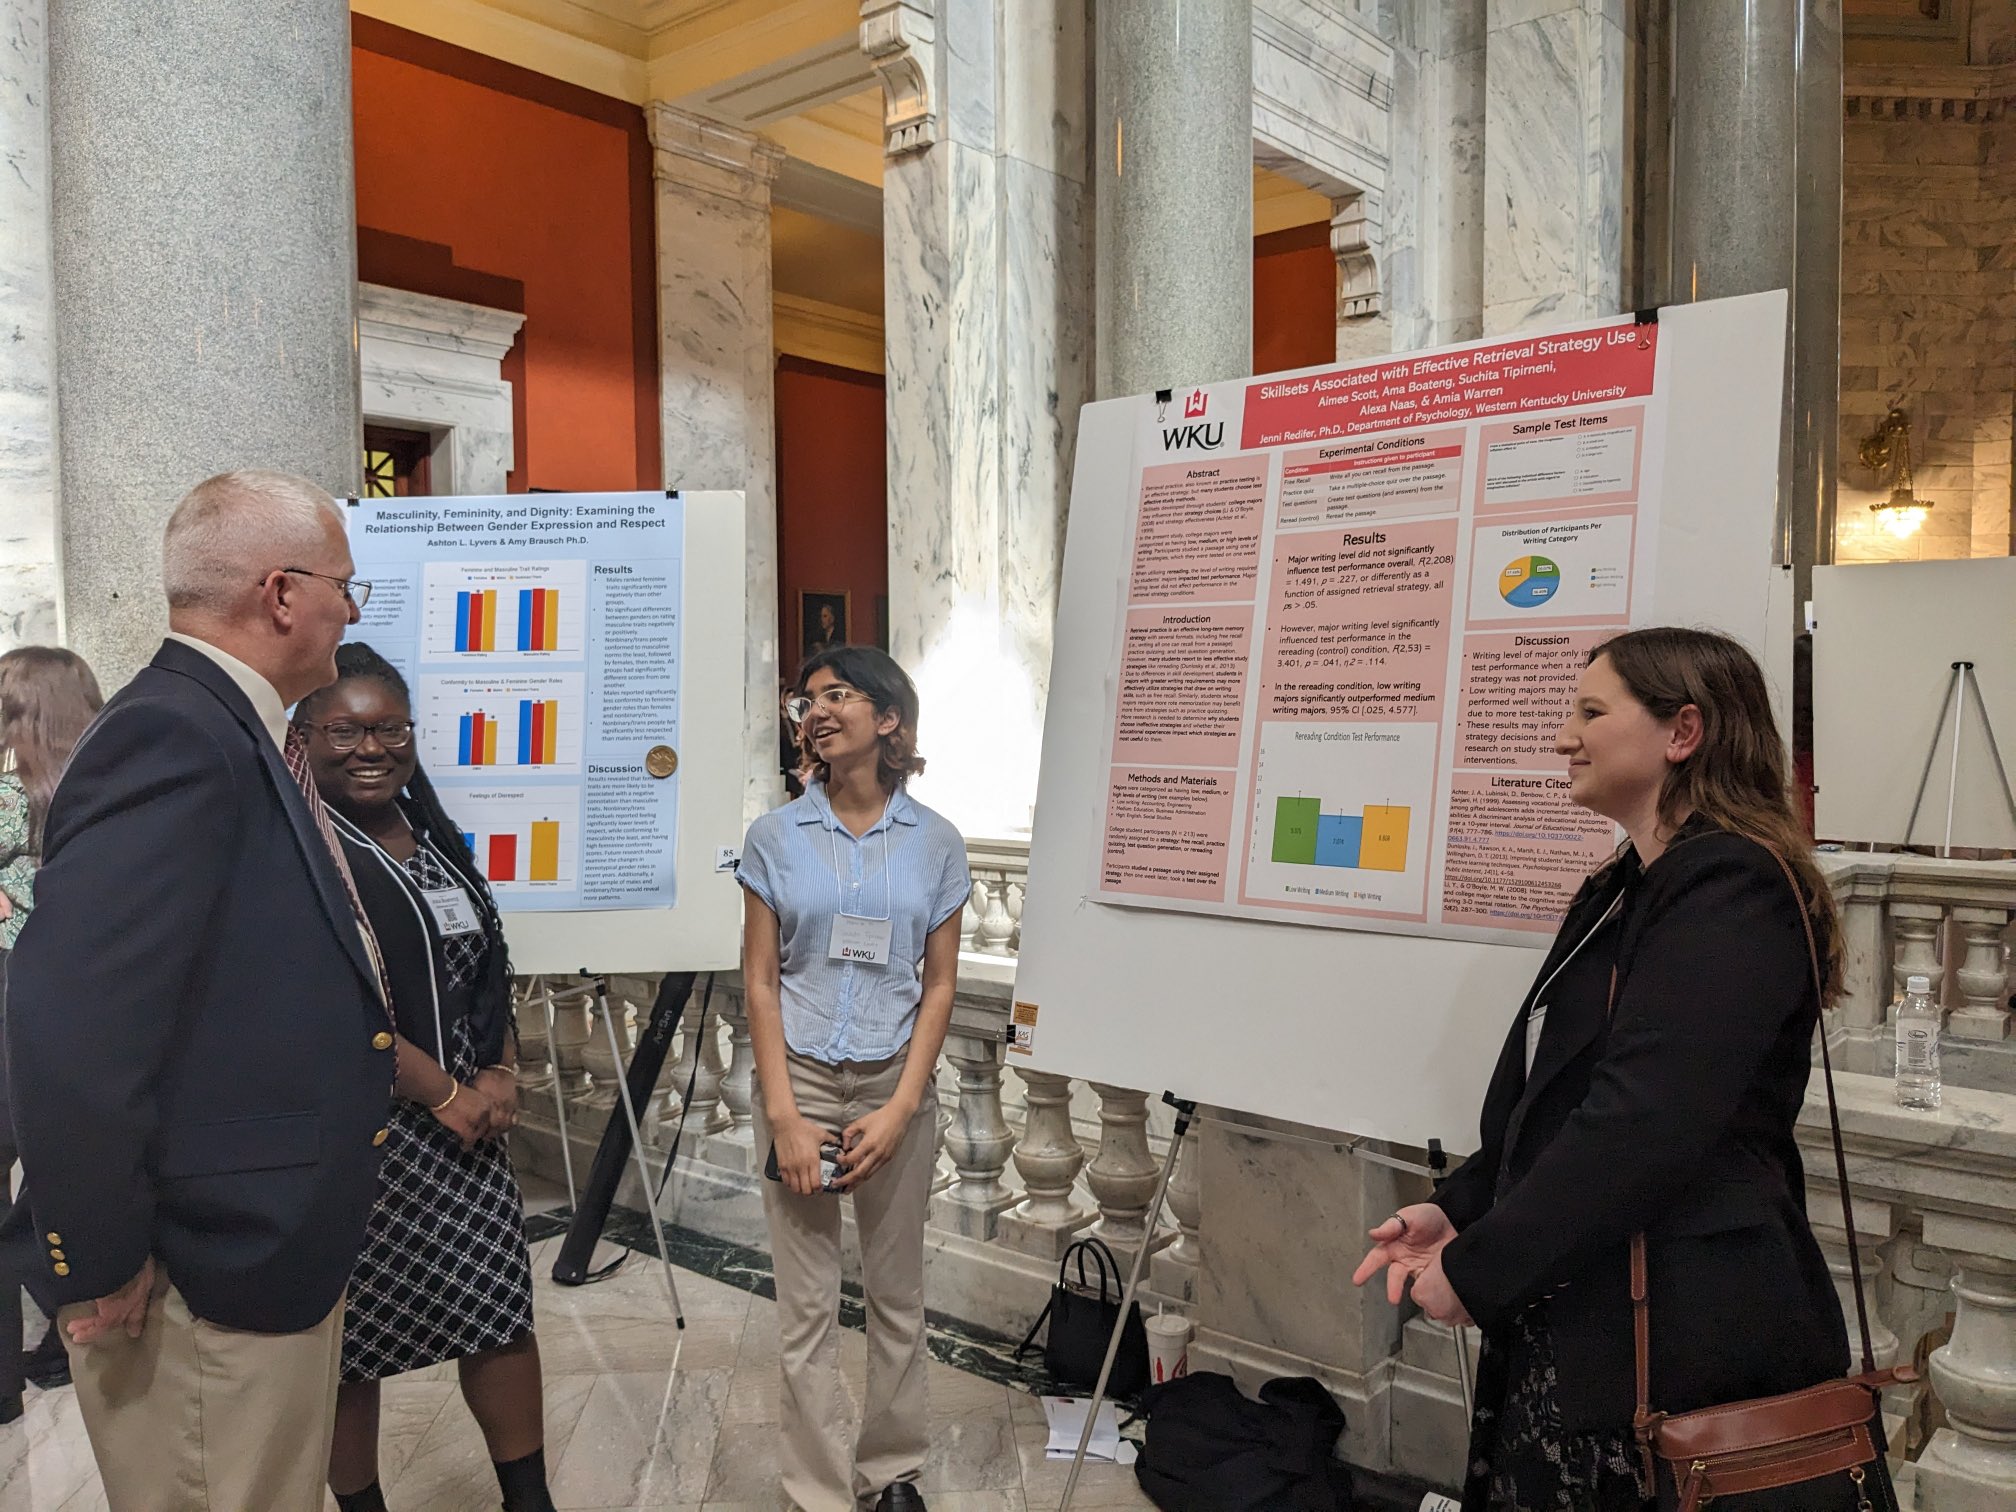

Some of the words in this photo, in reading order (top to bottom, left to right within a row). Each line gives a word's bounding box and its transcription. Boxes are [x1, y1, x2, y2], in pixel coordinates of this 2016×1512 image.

[1260, 383, 1308, 399] Skillsets
[1311, 371, 1378, 392] Associated
[1381, 365, 1408, 380] with
[1412, 357, 1469, 375] Effective
[1472, 346, 1533, 365] Retrieval
[1538, 336, 1602, 355] Strategy
[1607, 332, 1635, 345] Use
[1318, 395, 1348, 407] Aimee
[1350, 388, 1379, 401] Scott,
[1381, 385, 1405, 396] Ama
[1408, 378, 1455, 392] Boateng,
[1458, 371, 1499, 384] Suchita
[1504, 361, 1556, 379] Tipirneni,
[1360, 404, 1386, 416] Alexa
[1389, 399, 1417, 411] Naas,
[1420, 395, 1429, 406] &
[1432, 392, 1460, 404] Amia
[1463, 387, 1503, 400] Warren
[1259, 432, 1281, 444] Jenni
[1283, 428, 1316, 440] Redifer,
[1319, 424, 1344, 436] Ph.D.,
[1347, 416, 1400, 432] Department
[1402, 414, 1413, 423] of
[1415, 407, 1472, 423] Psychology,
[1475, 401, 1516, 414] Western
[1520, 394, 1569, 408] Kentucky
[1572, 386, 1626, 401] University
[1513, 421, 1550, 434] Sample
[1554, 418, 1576, 429] Test
[1579, 416, 1607, 426] Items
[1163, 422, 1224, 450] WKU
[1319, 443, 1374, 459] Experimental
[1376, 437, 1424, 450] Conditions
[1187, 469, 1220, 478] Abstract
[376, 509, 440, 521] Masculinity,
[443, 508, 502, 519] Femininity,
[506, 507, 526, 517] and
[530, 506, 572, 518] Dignity:
[576, 505, 634, 516] Examining
[637, 505, 655, 514] the
[365, 523, 433, 534] Relationship
[437, 523, 484, 532] Between
[487, 521, 528, 531] Gender
[531, 520, 592, 531] Expression
[596, 519, 616, 528] and
[620, 518, 665, 530] Respect
[1502, 528, 1540, 536] Distribution
[1549, 524, 1589, 532] Participants
[469, 539, 497, 547] Lyvers
[507, 538, 527, 546] Amy
[1343, 532, 1386, 546] Results
[1288, 555, 1309, 565] Major
[1310, 553, 1336, 562] writing
[1338, 551, 1356, 559] level
[1357, 550, 1370, 558] did
[1387, 545, 1434, 557] significantly
[594, 565, 632, 574] Results
[1337, 562, 1385, 573] performance
[1285, 589, 1314, 598] function
[1316, 588, 1324, 596] of
[1326, 586, 1360, 596] assigned
[1362, 584, 1394, 593] retrieval
[1396, 583, 1431, 591] strategy,
[1433, 581, 1443, 589] all
[1162, 614, 1210, 623] Introduction
[1515, 636, 1569, 646] Discussion
[1472, 652, 1500, 660] Writing
[1534, 651, 1558, 659] major
[1560, 650, 1578, 659] only
[1488, 663, 1538, 672] performance
[1470, 675, 1502, 684] strategy
[1538, 674, 1578, 683] provided.
[1298, 683, 1334, 692] rereading
[1392, 682, 1420, 691] writing
[1273, 694, 1298, 703] majors
[1300, 694, 1345, 703] significantly
[1347, 694, 1401, 703] outperformed
[1295, 732, 1322, 742] Rereading
[1323, 732, 1350, 740] Condition
[1352, 732, 1363, 741] Test
[1364, 732, 1400, 741] Performance
[1464, 756, 1517, 764] interventions.
[588, 765, 643, 773] Discussion
[1128, 774, 1161, 783] Methods
[1163, 775, 1178, 784] and
[1180, 775, 1217, 785] Materials
[1491, 777, 1542, 788] Literature
[450, 920, 470, 930] WKU
[852, 950, 876, 960] WKU
